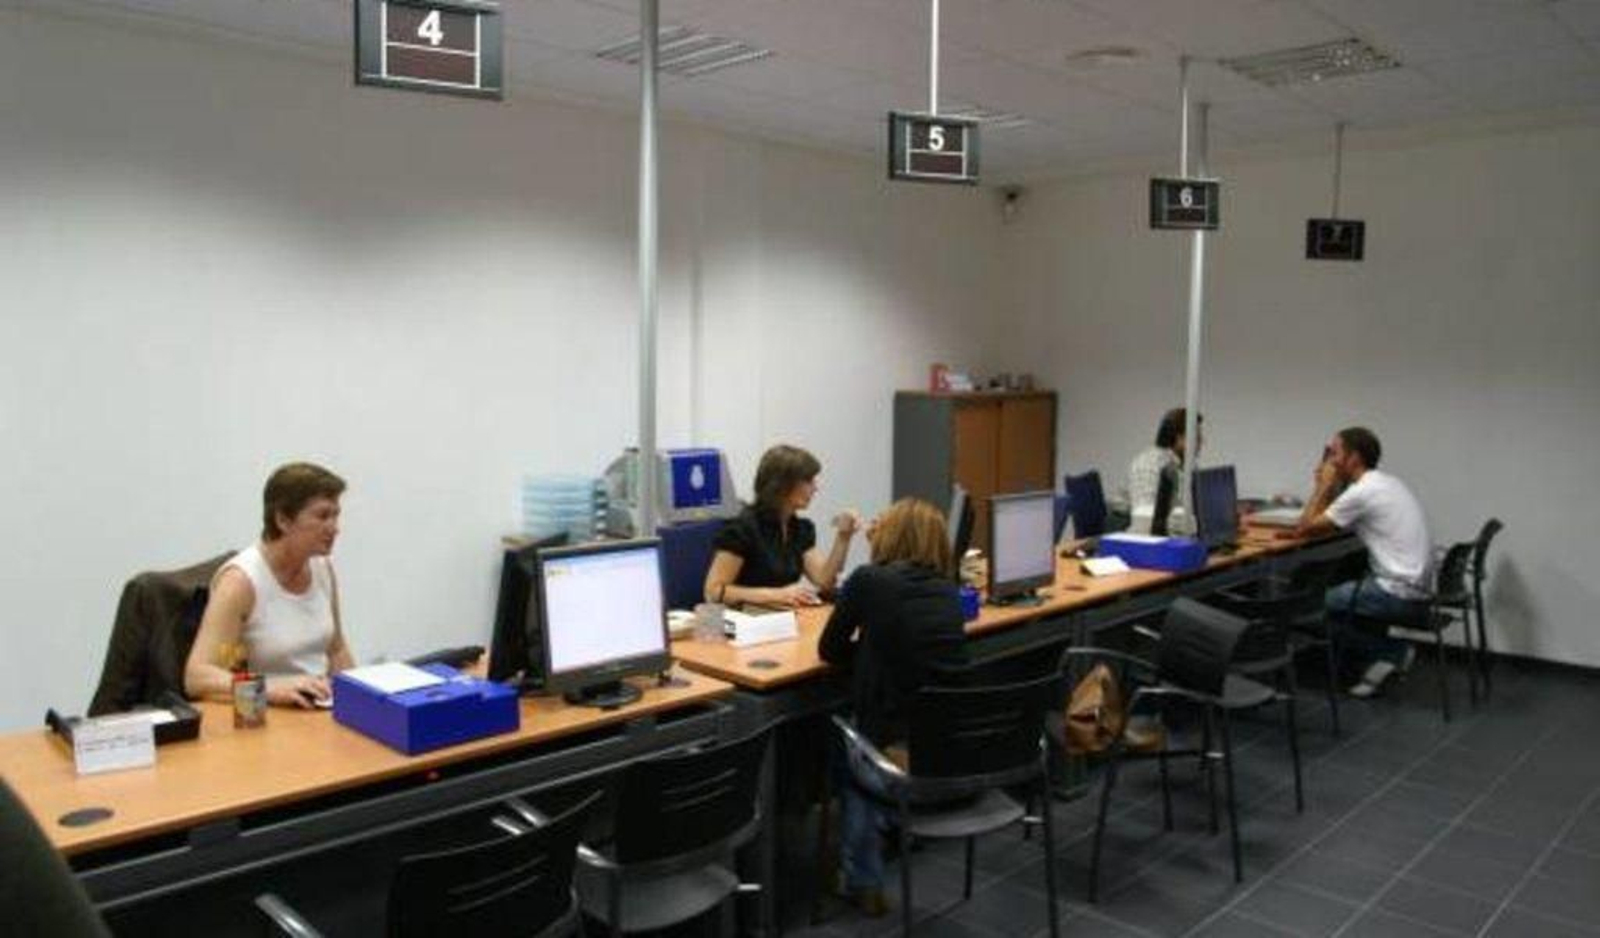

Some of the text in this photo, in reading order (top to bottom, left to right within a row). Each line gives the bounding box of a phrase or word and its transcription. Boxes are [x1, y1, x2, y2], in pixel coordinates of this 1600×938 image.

[417, 10, 444, 46] 4
[929, 125, 945, 151] 5
[1180, 186, 1193, 208] 6
